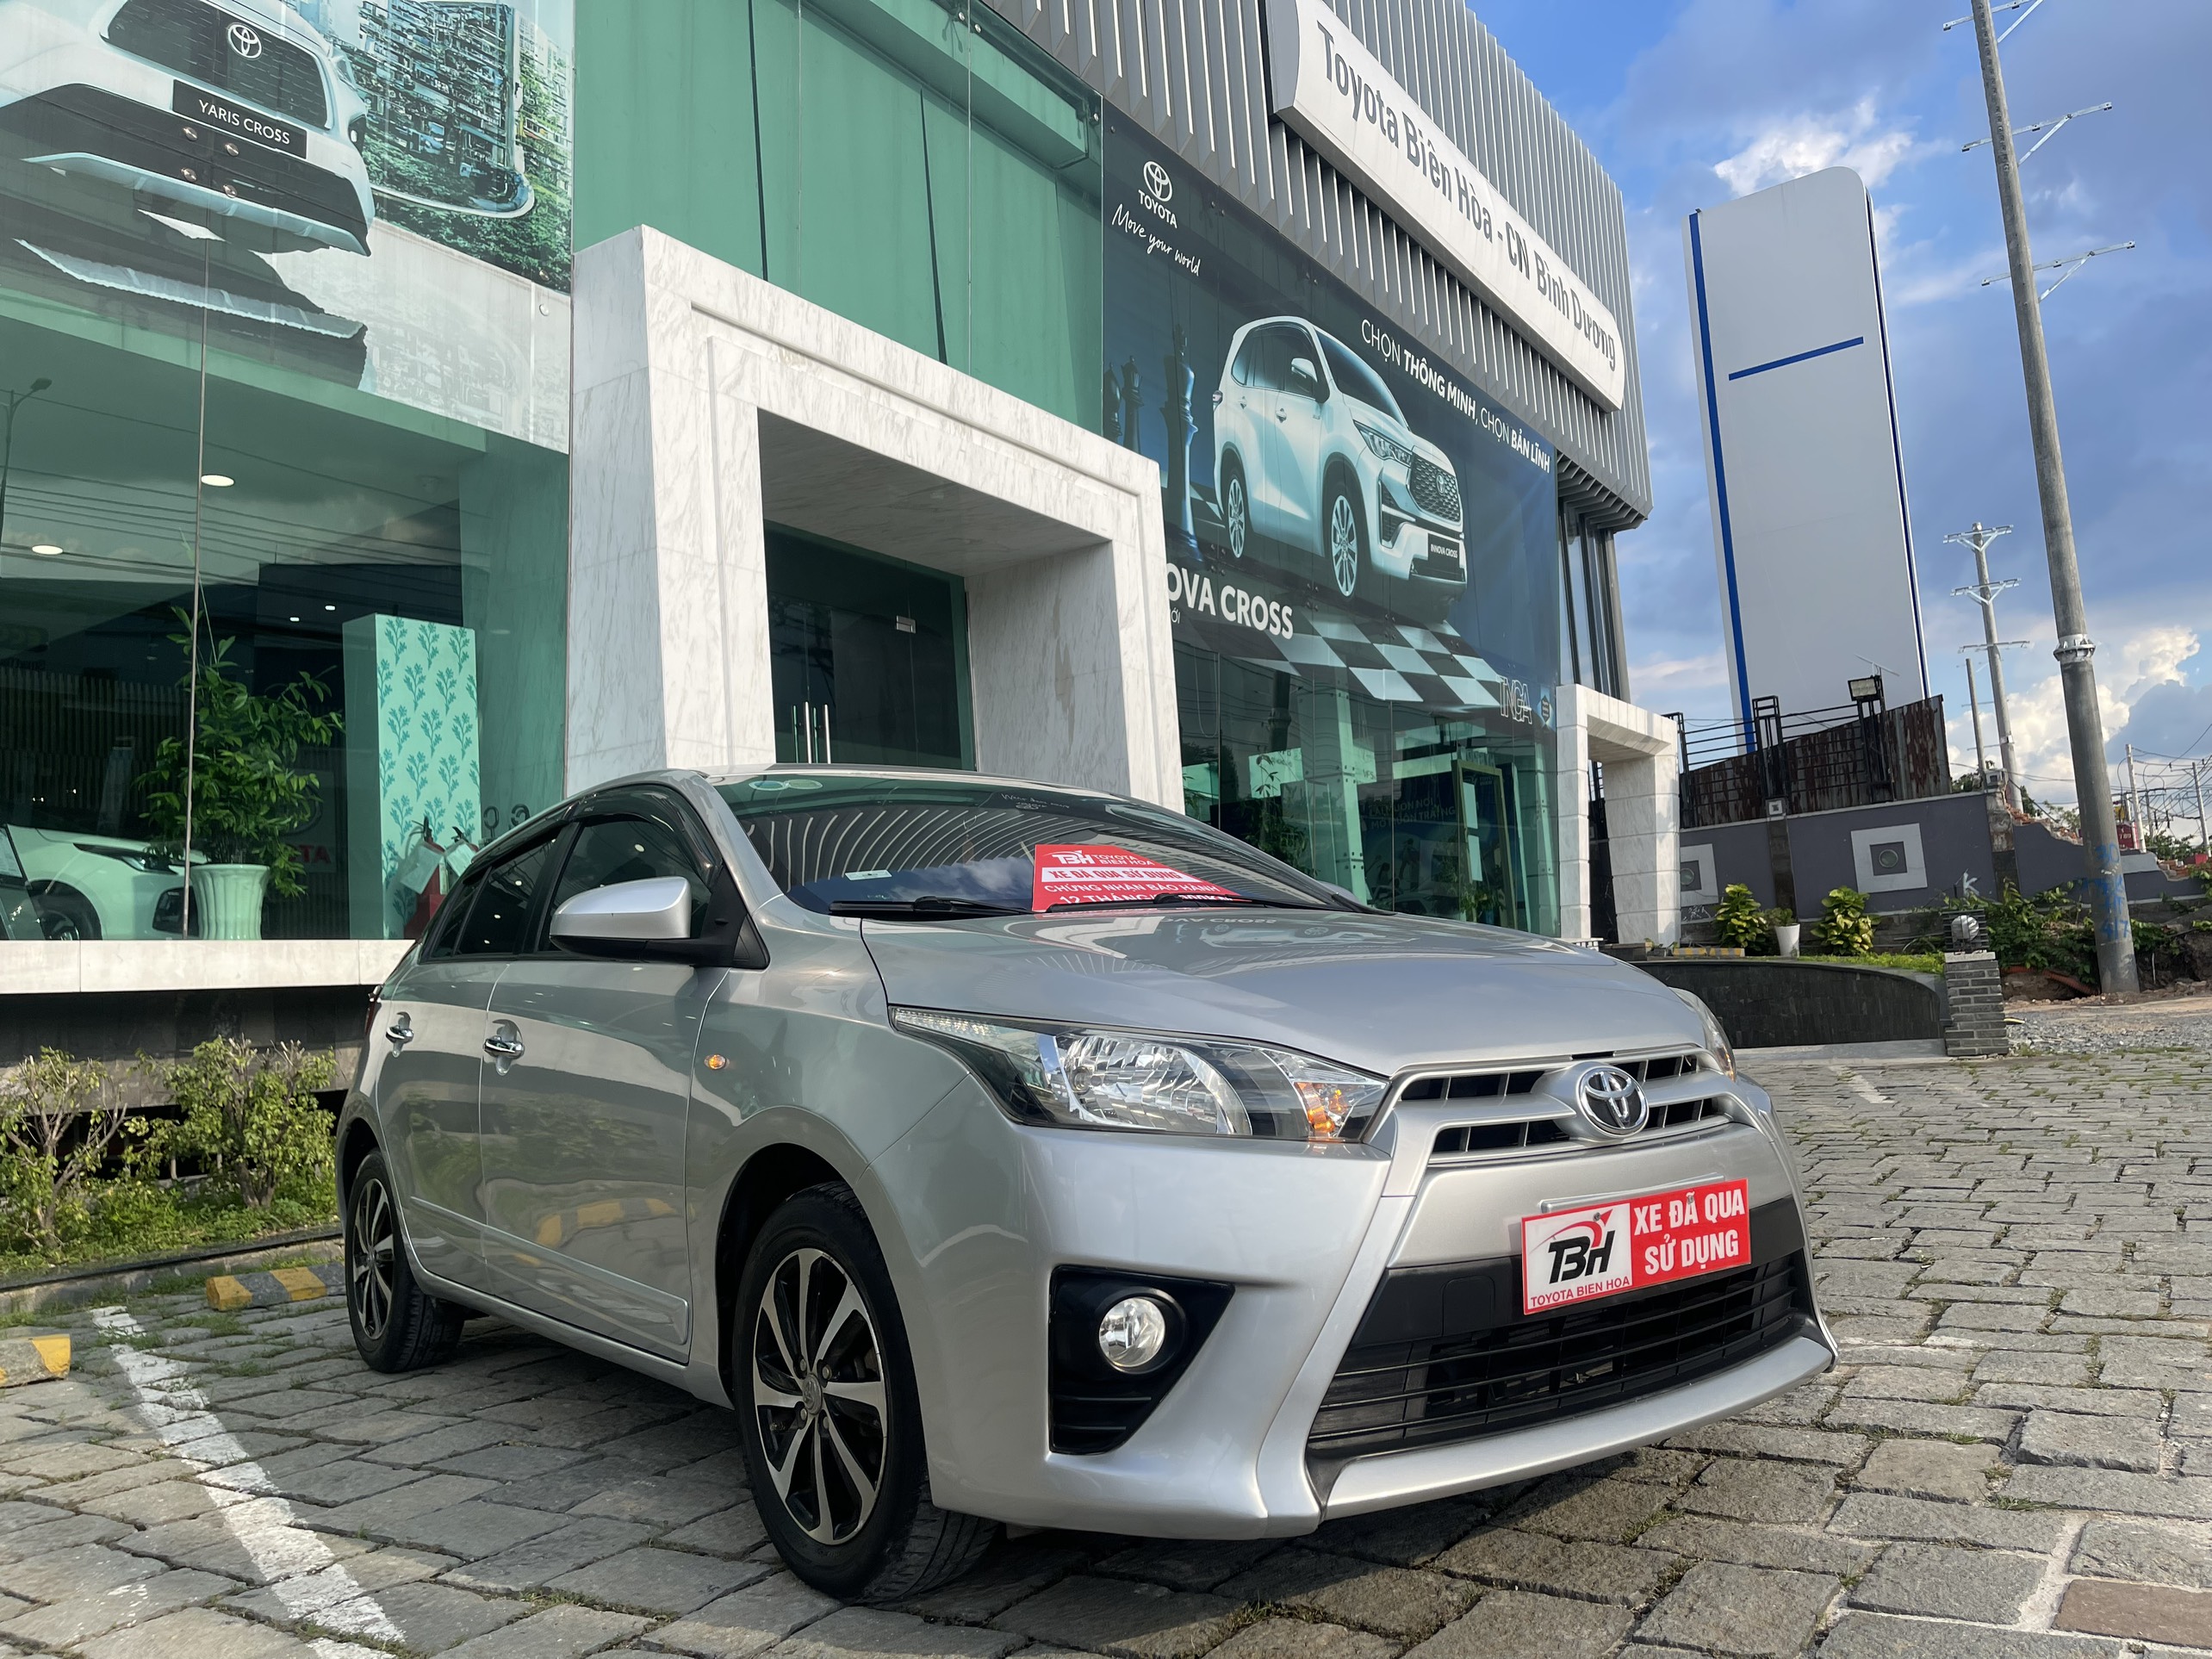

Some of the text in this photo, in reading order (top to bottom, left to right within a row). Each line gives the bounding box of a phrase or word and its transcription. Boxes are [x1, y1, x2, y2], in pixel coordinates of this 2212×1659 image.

[198, 98, 290, 145] YARIS CROSS
[1138, 189, 1177, 229] TOYOTA
[1316, 20, 1400, 149] Toyota
[1401, 111, 1452, 203] Biên
[1454, 166, 1493, 244] Hòa
[1505, 221, 1531, 281] CN
[1533, 250, 1570, 320] Bình
[1569, 288, 1616, 372] Dương
[1111, 203, 1202, 276] Move your world
[1361, 319, 1401, 366] CHỌN
[1403, 348, 1446, 399] THÔNG
[1480, 407, 1510, 444] CHỌN
[1511, 428, 1530, 459] BẢN
[1530, 441, 1550, 474] LĨNH
[1430, 544, 1458, 558] INNOVA CROSS
[1220, 584, 1294, 640] CROSS
[1048, 870, 1072, 879] XE
[1092, 869, 1124, 879] QUA
[1142, 870, 1183, 880] DỤNG
[1051, 851, 1097, 865] TBH
[1633, 1189, 1746, 1236] XE ĐÃ QUA
[1547, 1229, 1616, 1284] TBH
[1644, 1229, 1739, 1275] SỬ DỤNG
[1530, 1276, 1631, 1308] TOYOTA BIEN HOA
